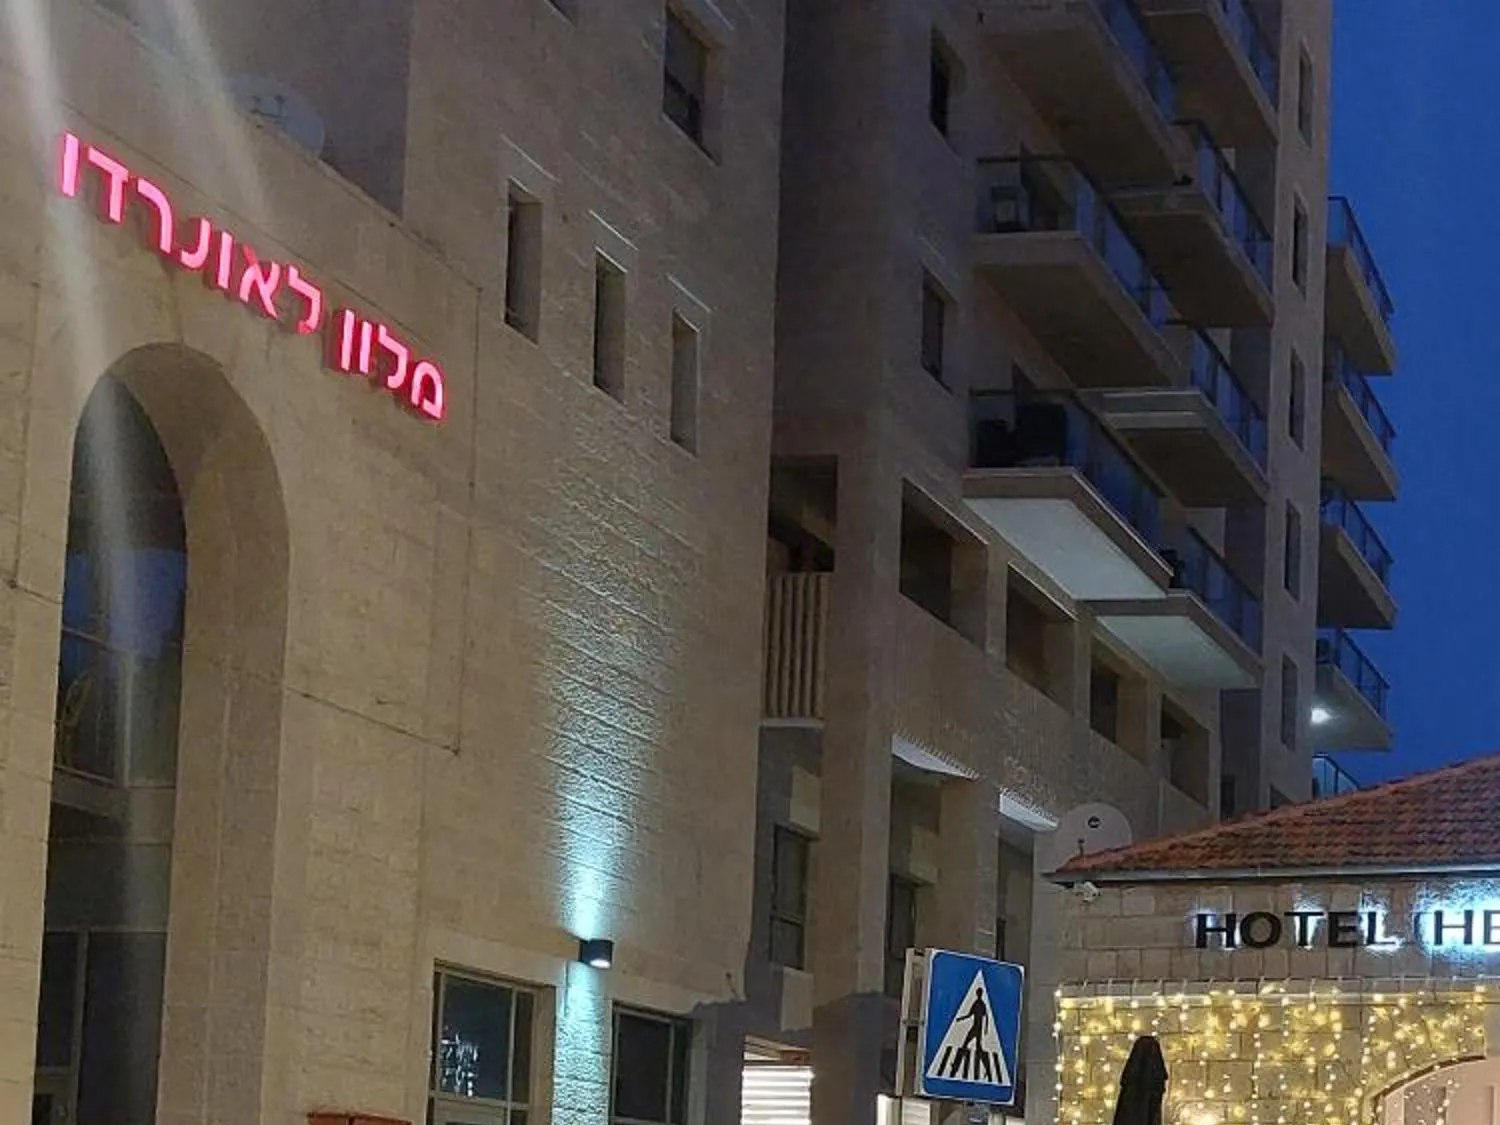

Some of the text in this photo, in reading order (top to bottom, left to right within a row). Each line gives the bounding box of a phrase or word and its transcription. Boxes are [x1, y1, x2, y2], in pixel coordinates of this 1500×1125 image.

[60, 130, 444, 421] מלון לאונרדו
[1195, 910, 1398, 949] HOTEL
